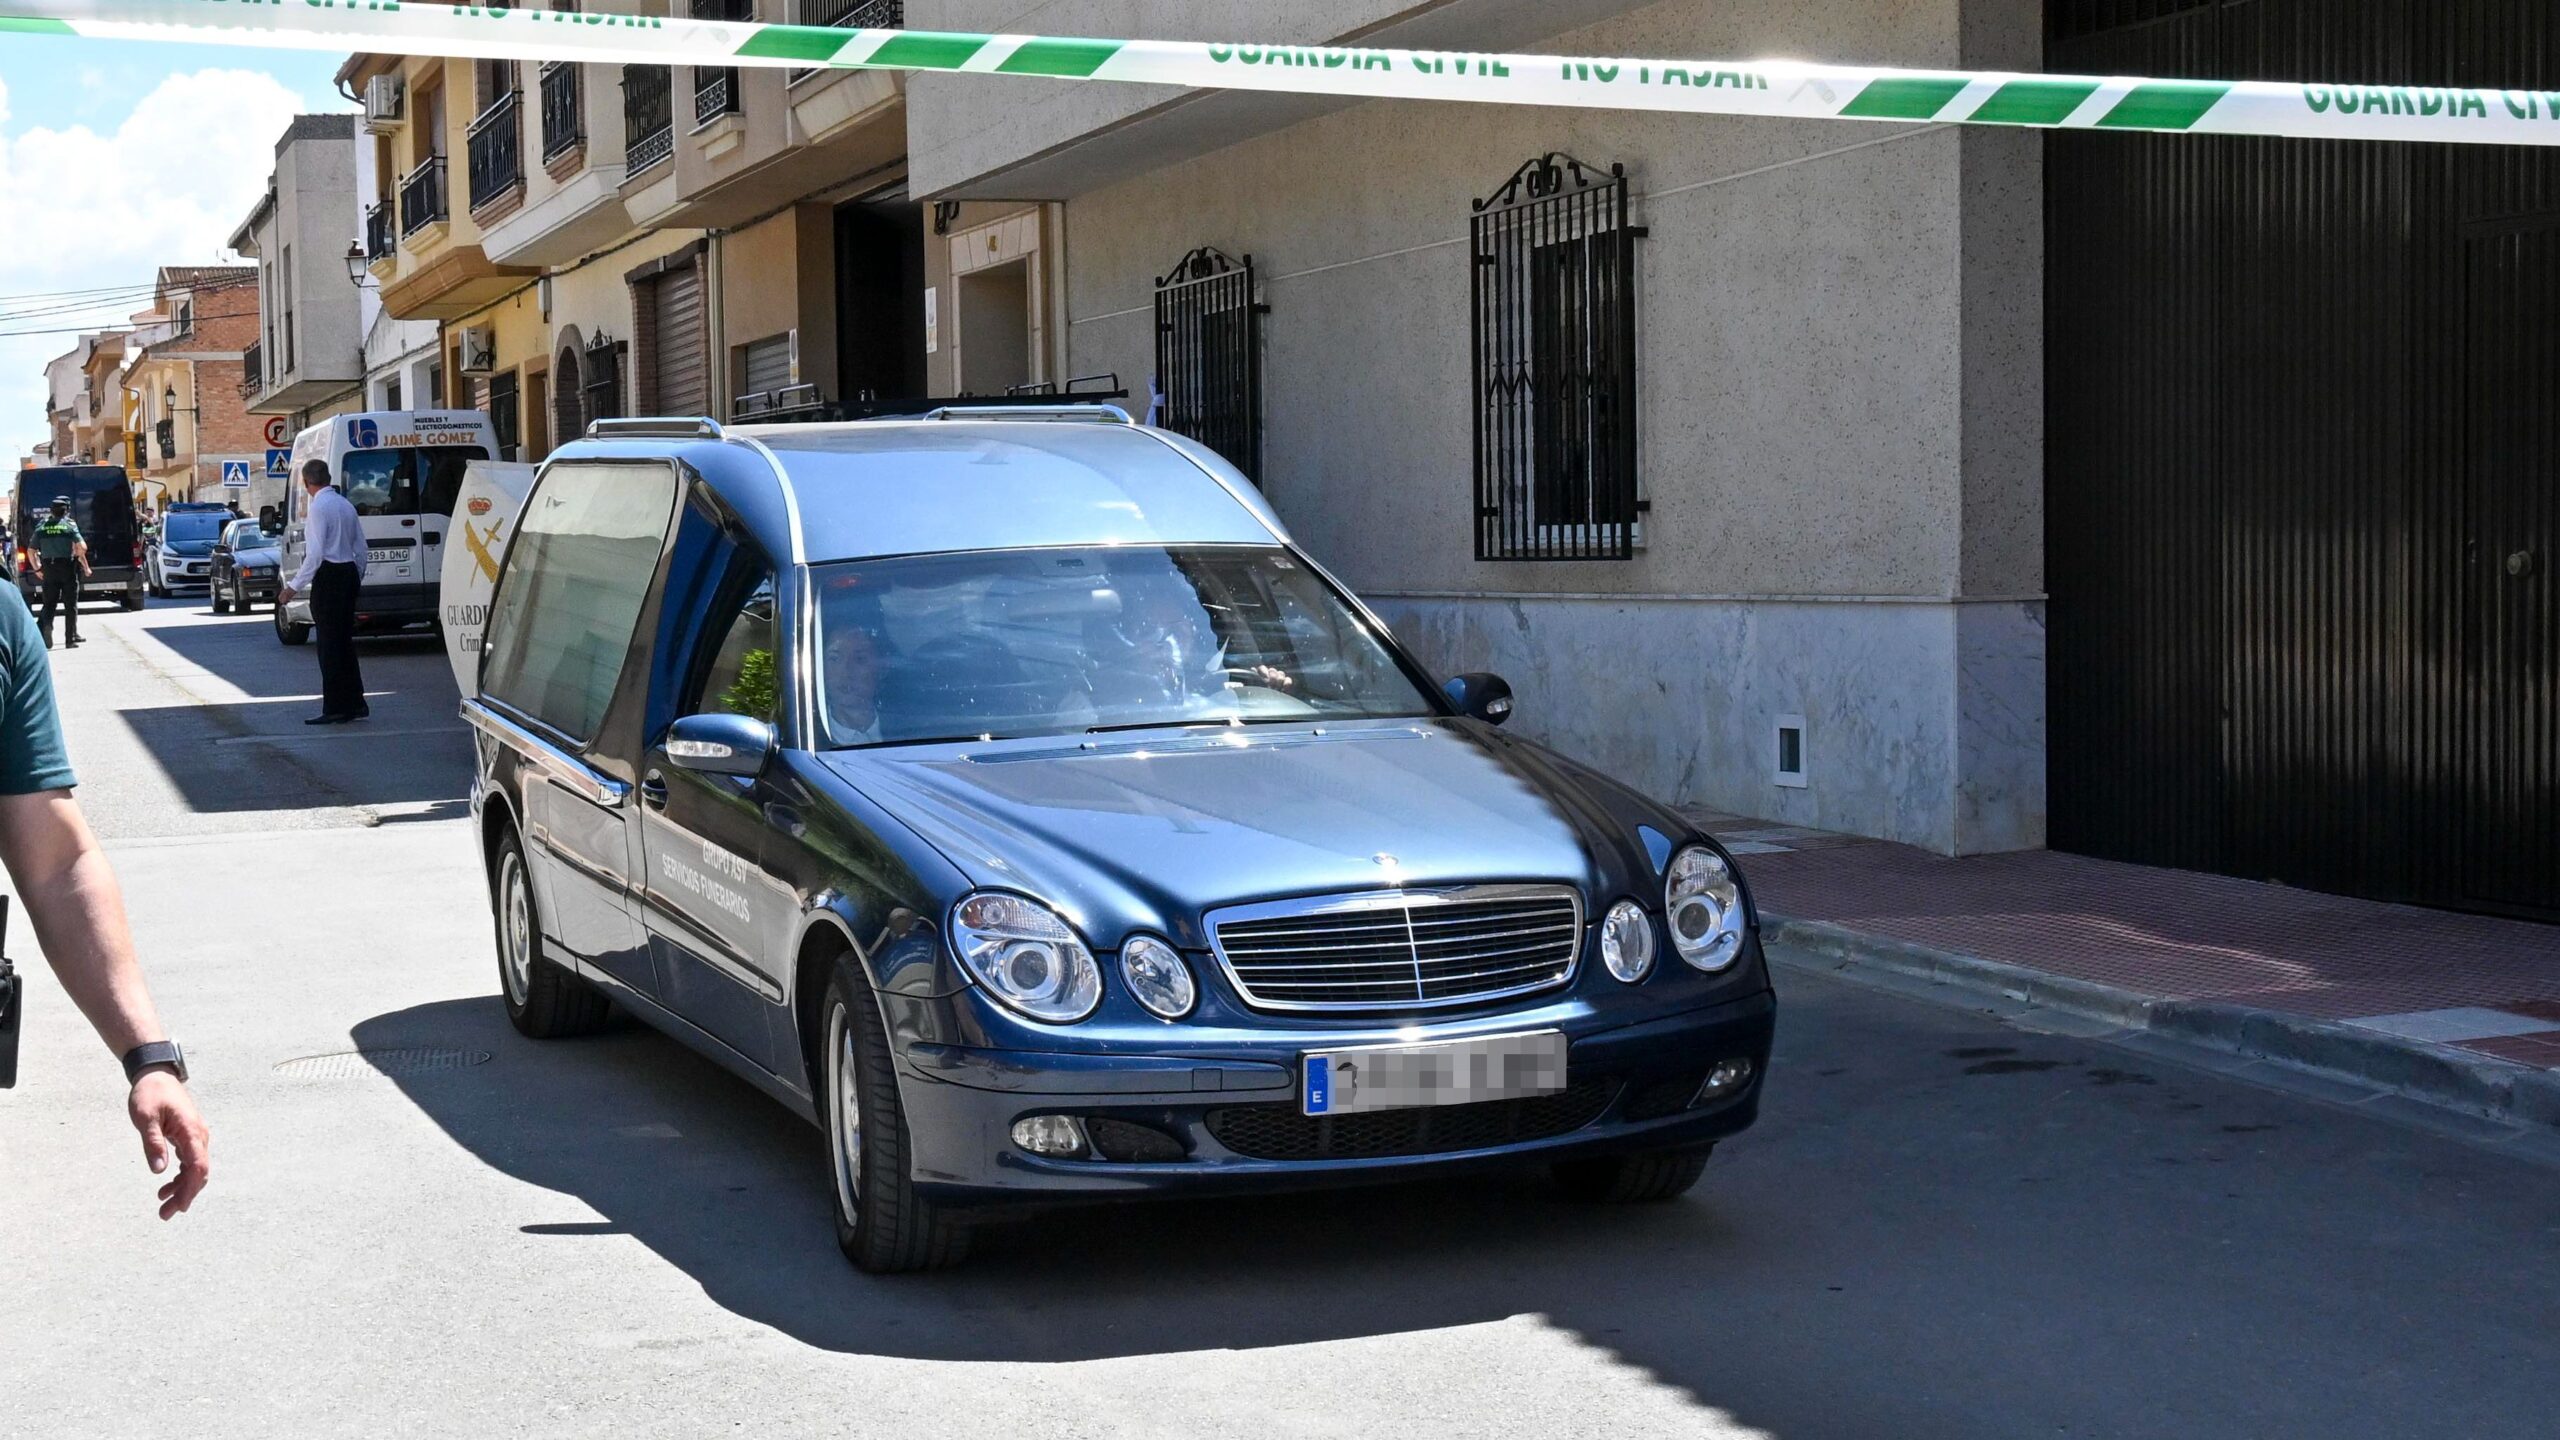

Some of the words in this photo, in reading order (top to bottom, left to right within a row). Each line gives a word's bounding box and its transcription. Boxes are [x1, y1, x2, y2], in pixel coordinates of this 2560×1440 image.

[384, 433, 422, 447] JAIME
[426, 431, 476, 444] GÓMEZ
[703, 840, 730, 874] GRUPO
[731, 856, 748, 884] ASV
[661, 853, 700, 893] SERVICIOS
[700, 875, 750, 922] FUNERARIOS
[1312, 1090, 1322, 1104] E
